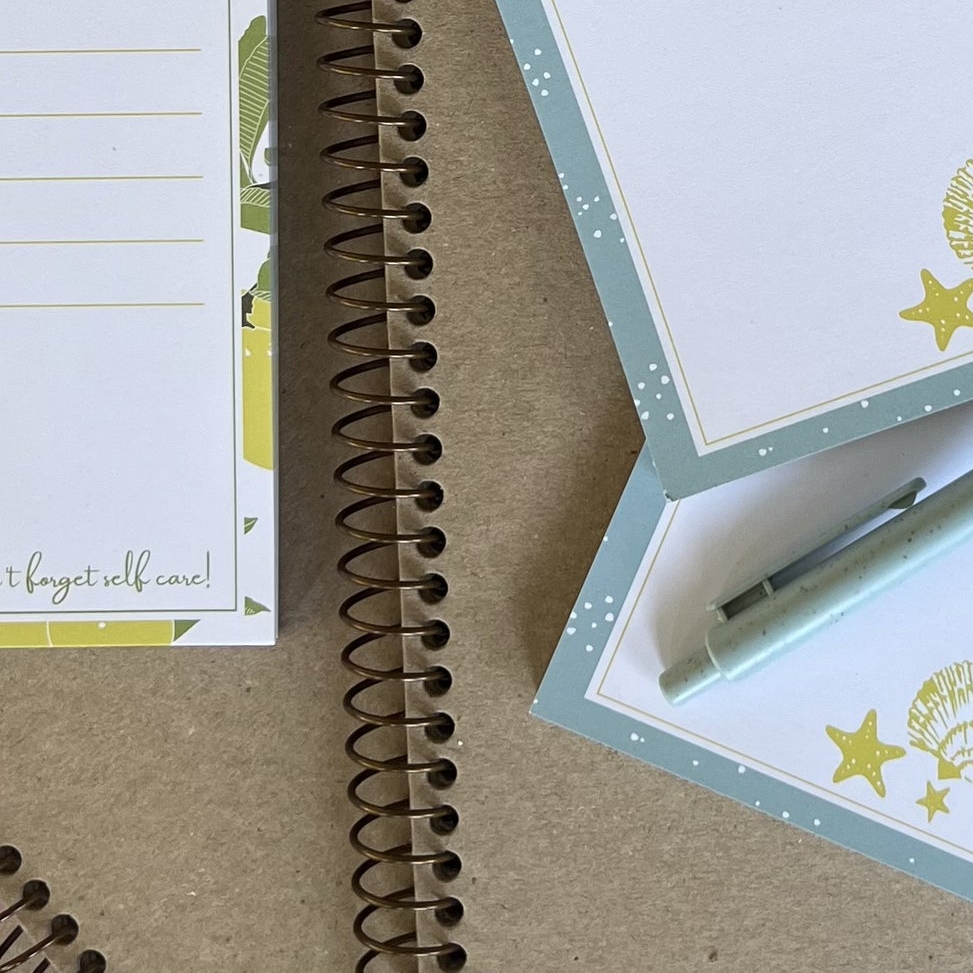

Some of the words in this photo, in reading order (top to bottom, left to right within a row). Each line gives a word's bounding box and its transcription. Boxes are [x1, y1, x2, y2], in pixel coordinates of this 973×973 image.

[26, 550, 100, 605] forget
[103, 549, 151, 593] self
[155, 549, 211, 589] care!
